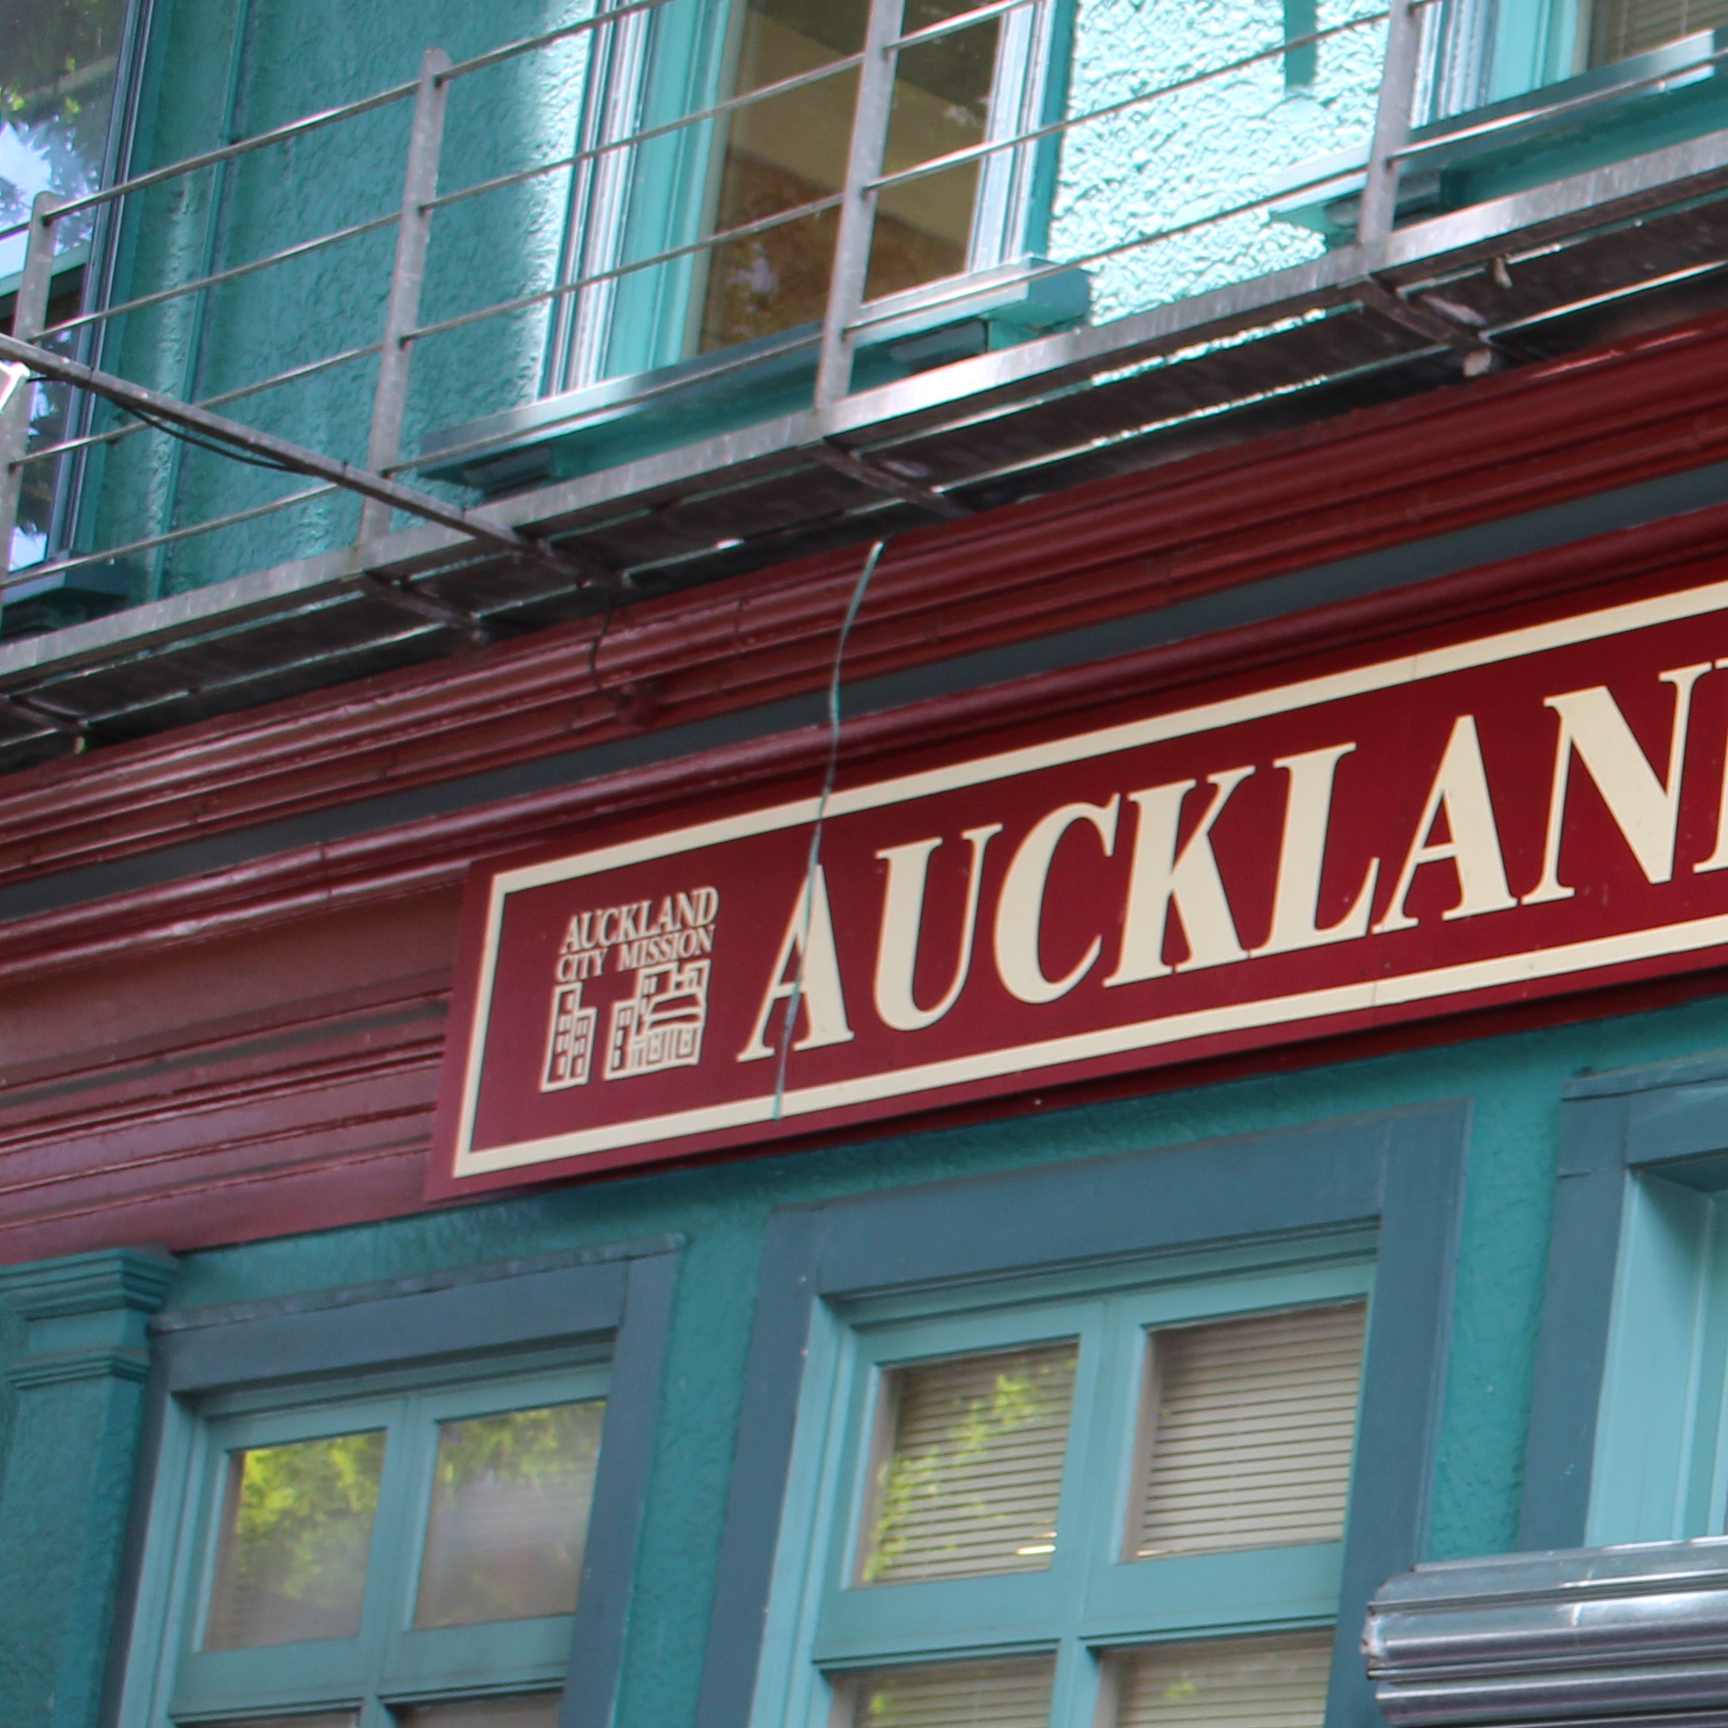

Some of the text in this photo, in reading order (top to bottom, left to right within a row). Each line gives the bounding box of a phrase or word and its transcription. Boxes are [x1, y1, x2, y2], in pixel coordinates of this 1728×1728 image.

[560, 886, 719, 954] AUCKLAND
[555, 924, 716, 983] CITY MISSION
